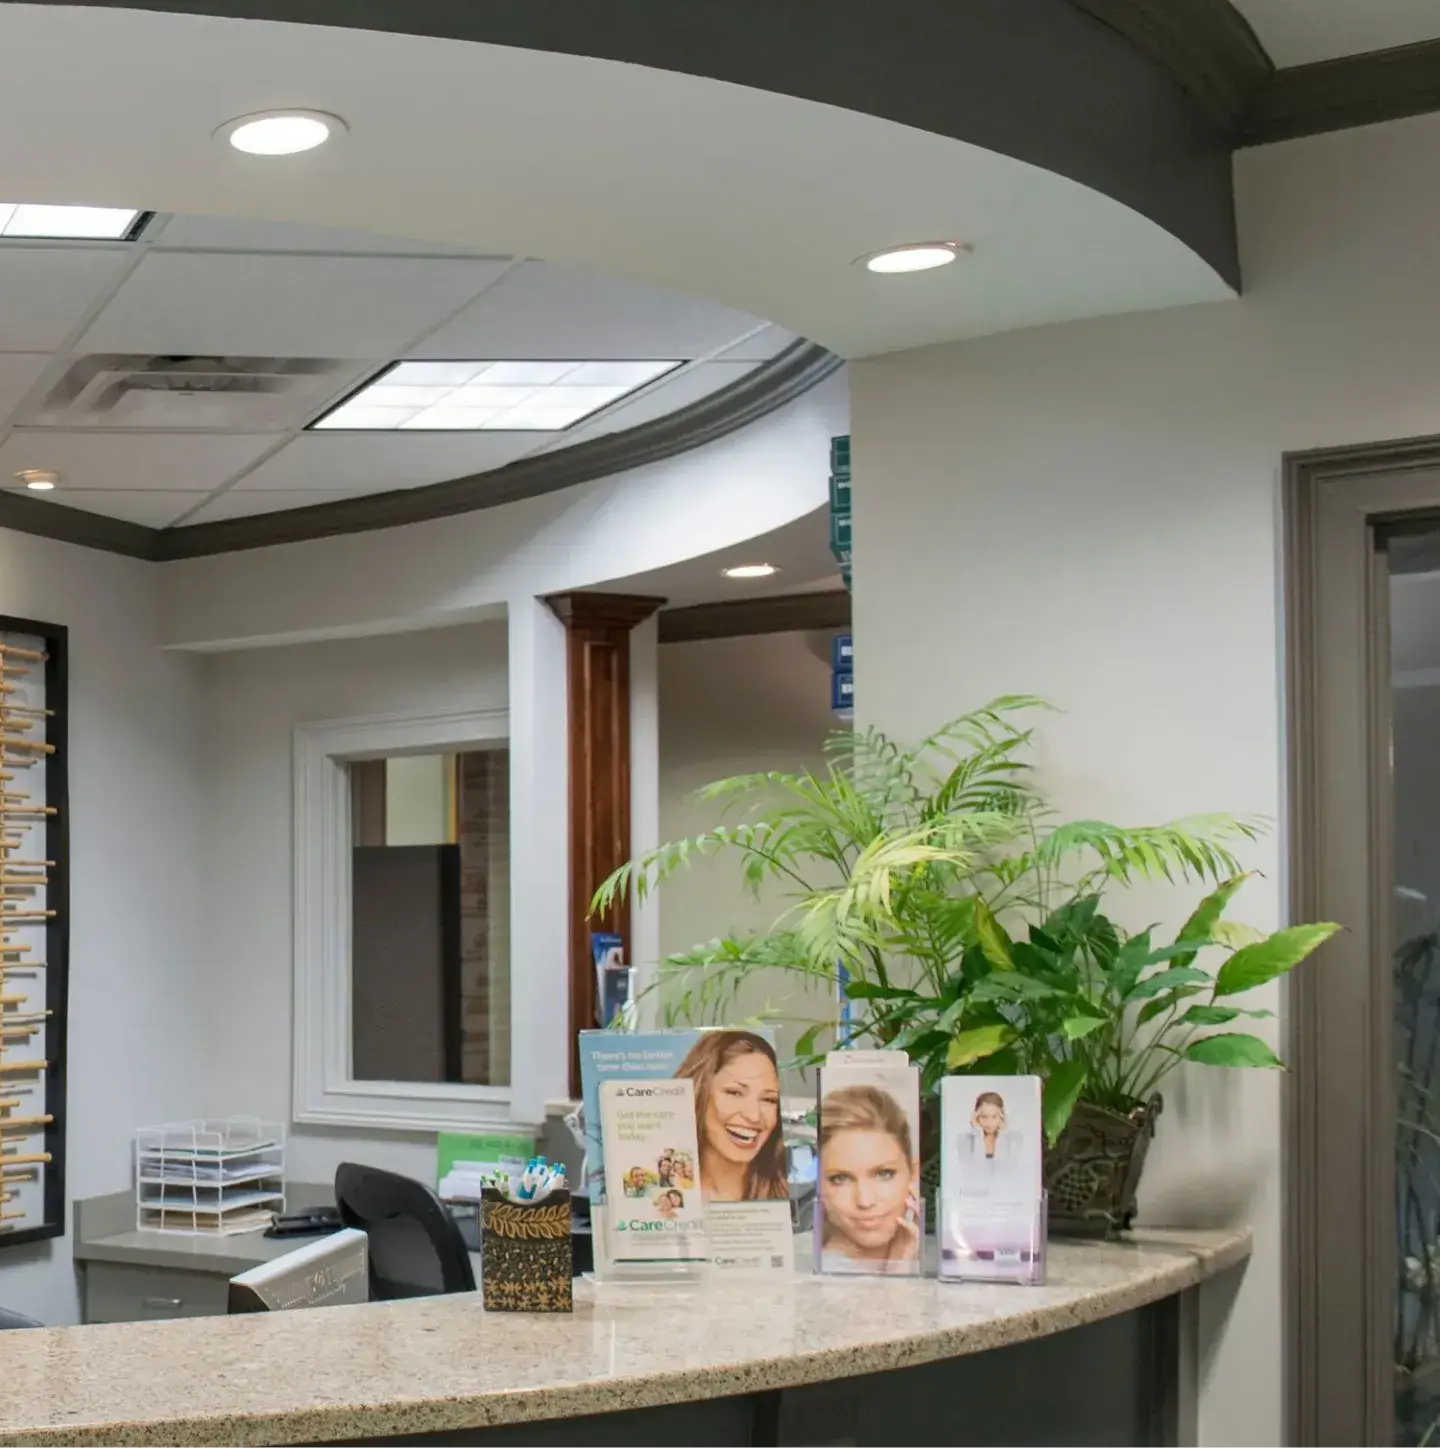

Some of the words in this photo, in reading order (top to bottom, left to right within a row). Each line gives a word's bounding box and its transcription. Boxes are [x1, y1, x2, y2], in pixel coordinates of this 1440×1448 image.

[626, 1086, 686, 1097] CareCredit
[616, 1110, 634, 1120] Get
[629, 1219, 703, 1232] CareCredit
[714, 1256, 761, 1266] CareCredit
